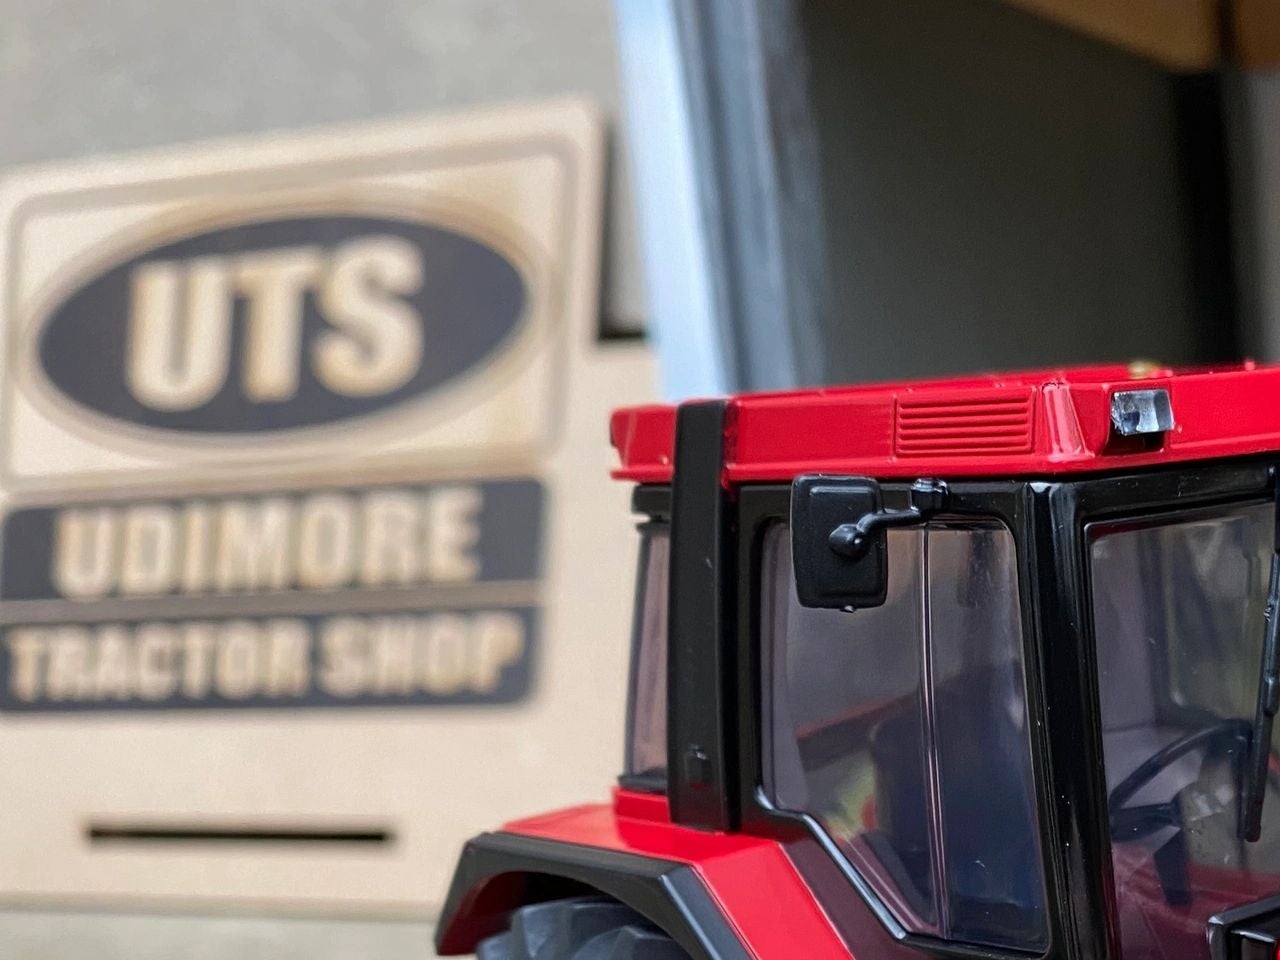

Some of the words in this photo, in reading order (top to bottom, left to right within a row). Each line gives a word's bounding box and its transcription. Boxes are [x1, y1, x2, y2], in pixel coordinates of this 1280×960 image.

[127, 235, 423, 411] UTS
[56, 486, 480, 599] UDIMORE
[9, 621, 309, 701] TRACTOR
[319, 612, 523, 695] SHOP
